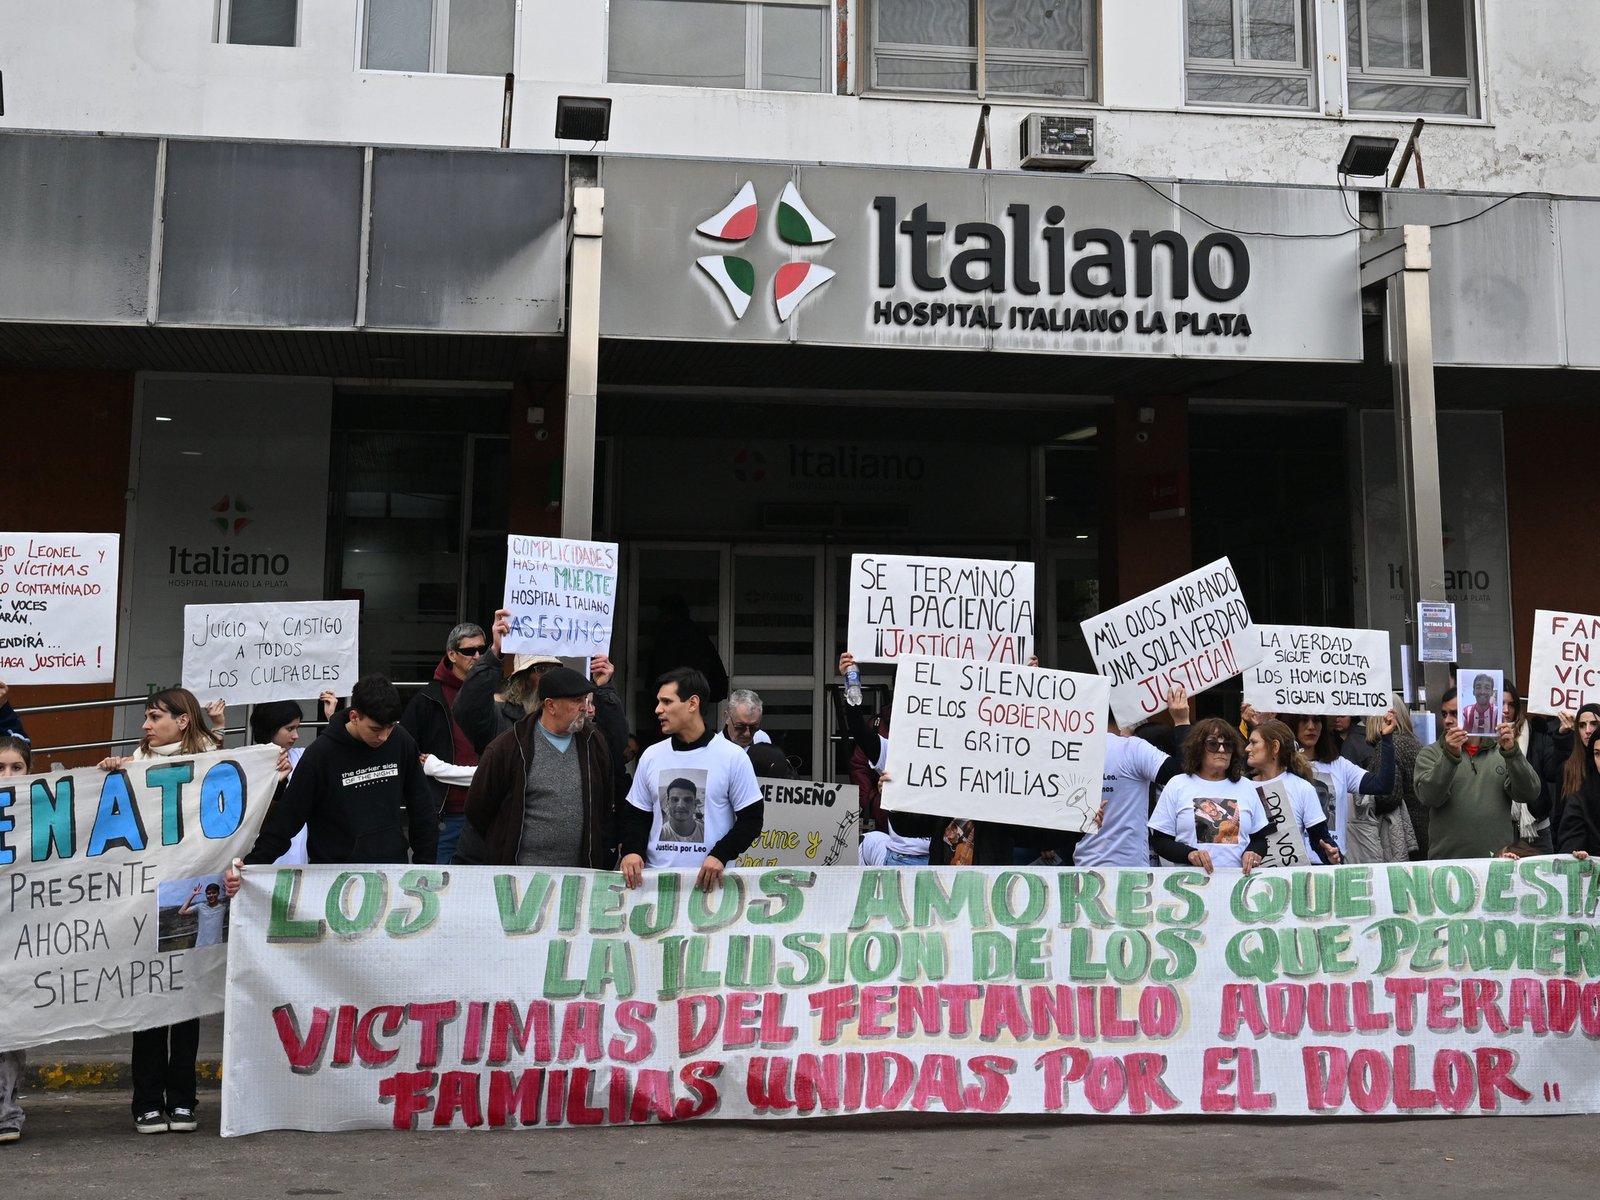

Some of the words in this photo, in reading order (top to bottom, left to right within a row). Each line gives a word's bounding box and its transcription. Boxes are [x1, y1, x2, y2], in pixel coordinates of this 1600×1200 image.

[873, 196, 1250, 303] Italiano
[874, 301, 1002, 329] HOSPITAL
[1010, 306, 1128, 333] ITALIANO
[1136, 310, 1168, 334] LA
[1175, 311, 1252, 337] PLATA
[789, 444, 924, 480] Italiano
[28, 539, 81, 558] LEONEL
[169, 546, 289, 575] Italiano
[513, 537, 614, 569] COMPLICIDADES
[14, 560, 89, 576] VÍCTIMAS
[513, 558, 548, 572] HASTA
[861, 558, 887, 590] SE
[906, 563, 1017, 598] TERMINÓ
[1388, 563, 1489, 590] Itano
[16, 582, 101, 596] CONTAMINADO
[211, 580, 249, 588] ITALIANO
[252, 580, 262, 588] LA
[264, 580, 288, 588] PLATA
[519, 573, 537, 585] LA
[554, 566, 614, 597] MUERTE
[11, 600, 47, 611] VOCES
[511, 589, 560, 607] HOSPITAL
[565, 595, 609, 615] ITALIANO
[867, 596, 895, 625] LA
[910, 595, 1034, 635] PACIENCIA
[1094, 622, 1126, 655] MIL
[1126, 600, 1166, 637] OJOS
[1170, 566, 1238, 619] MIRANDO
[192, 614, 246, 646] JUICIO
[259, 620, 269, 641] Y
[283, 617, 342, 636] CASTIGO
[510, 615, 605, 645] ASESINO
[1102, 651, 1144, 687] UNA
[1142, 631, 1187, 672] SOLA
[1180, 598, 1249, 650] VERDAD
[1260, 631, 1281, 647] LA
[1290, 633, 1352, 652] VERDAD
[29, 653, 85, 671] JUSTICIA
[235, 645, 244, 660] A
[254, 642, 302, 659] TODOS
[1274, 649, 1310, 663] SIGUE
[1320, 651, 1370, 669] OCULTA
[1562, 641, 1589, 662] EN
[209, 669, 238, 688] LOS
[251, 665, 340, 686] CULPABLES
[915, 662, 941, 686] EL
[960, 665, 1076, 701] SILENCIO
[1257, 668, 1282, 684] LOS
[1290, 669, 1367, 686] HOMICIDAS
[1555, 664, 1600, 687] VÍC
[1275, 687, 1325, 704] SIGUEN
[1331, 690, 1387, 707] SUELTOS
[978, 696, 1095, 734] GOBIERNOS
[917, 728, 943, 749] EL
[964, 730, 1030, 756] GRITO
[1051, 741, 1083, 761] DE
[355, 765, 380, 775] darker
[907, 763, 947, 787] LAS
[960, 767, 1060, 797] FAMILIAS
[655, 843, 678, 851] Justicia
[11, 861, 157, 912] PRESENTE
[266, 869, 450, 943] LOS
[494, 868, 817, 938] VIEJOS
[848, 869, 1210, 930] AMORES
[1230, 866, 1374, 924] QUE
[1387, 864, 1480, 916] NO
[14, 918, 110, 960] AHORA
[132, 913, 148, 946] Y
[543, 938, 635, 1000] LA
[656, 930, 948, 1000] ILUSION
[972, 927, 1052, 983] DE
[1069, 926, 1206, 984] LOS
[1224, 923, 1360, 984] QUE
[1360, 917, 1600, 977] PERDIER
[34, 953, 184, 1008] SIEMPRE
[272, 1000, 657, 1075] VICTIMAS
[677, 992, 798, 1058] DEL
[808, 982, 1182, 1046] FENTANILO
[378, 1060, 727, 1130] FAMILIAS
[747, 1050, 1018, 1116] UNIDAS
[1033, 1047, 1184, 1114] POR
[1200, 1046, 1277, 1113] EL
[1301, 1044, 1535, 1114] DOLOR
